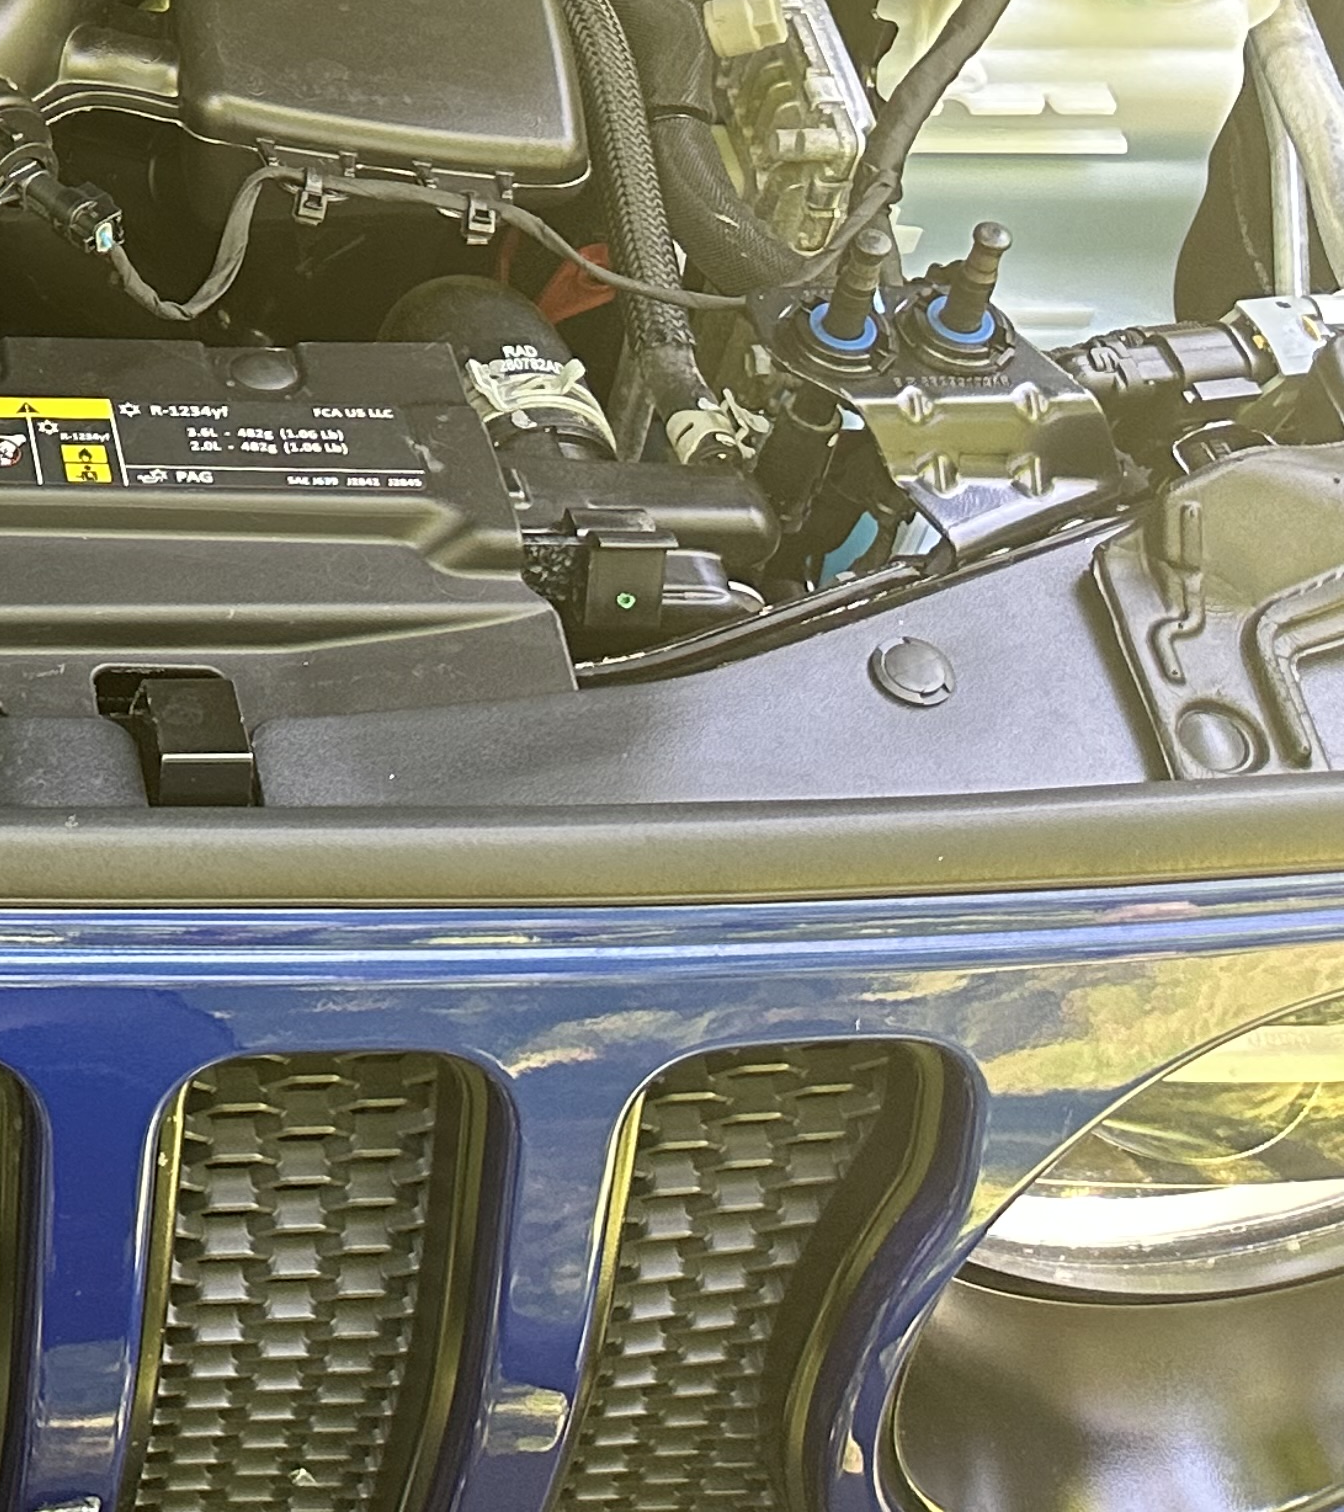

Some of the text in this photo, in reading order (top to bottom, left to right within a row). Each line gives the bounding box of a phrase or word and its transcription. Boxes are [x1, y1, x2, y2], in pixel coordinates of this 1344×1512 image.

[502, 344, 538, 358] RAD
[149, 404, 395, 421] R-1234yf FCA US LLC
[190, 440, 223, 452] 2.0L
[175, 470, 214, 483] PAG
